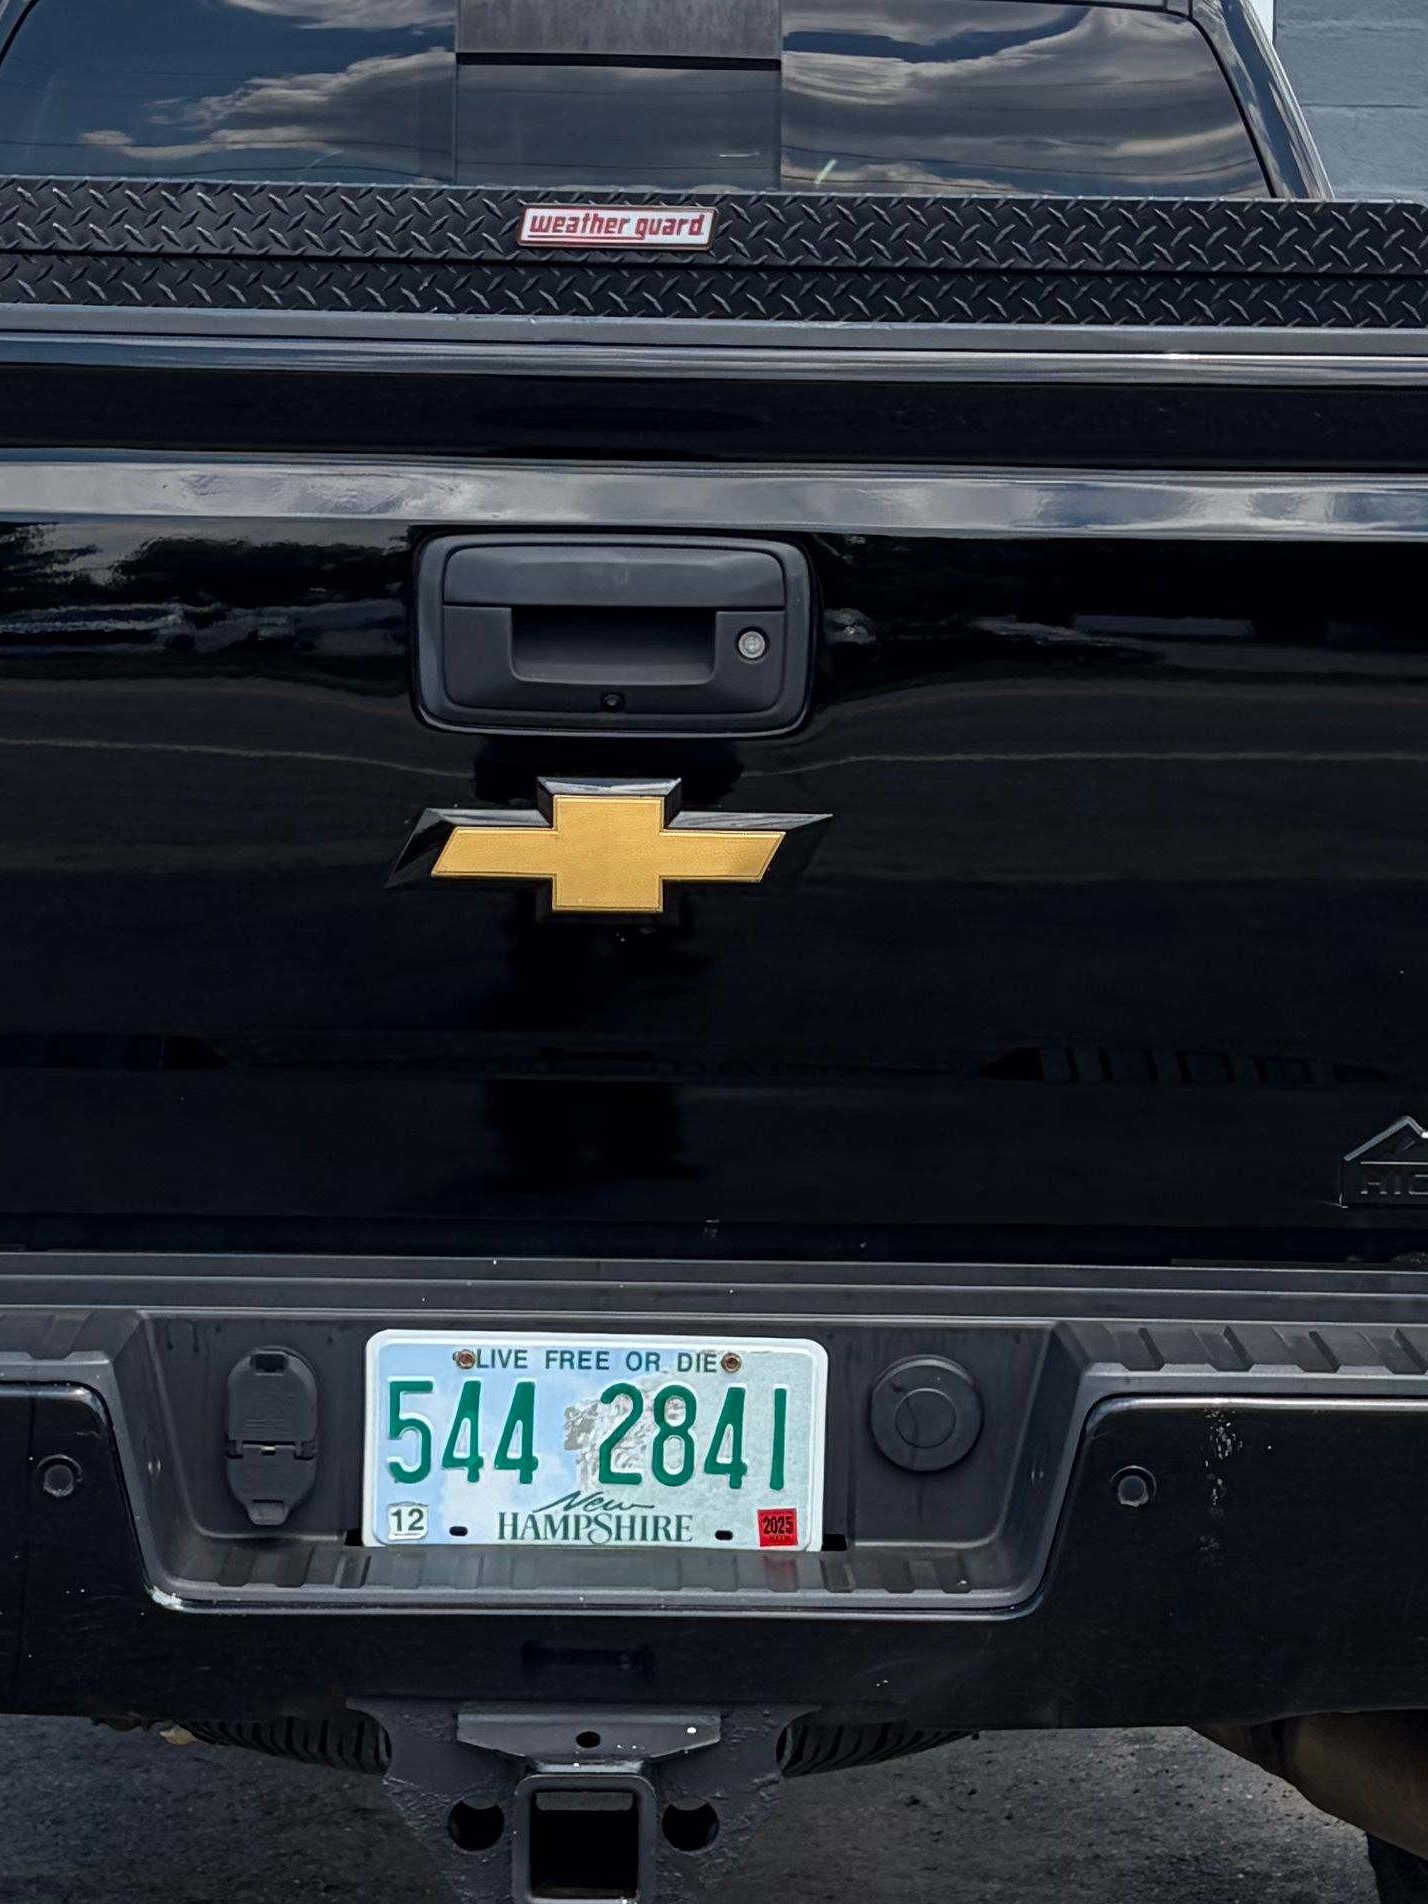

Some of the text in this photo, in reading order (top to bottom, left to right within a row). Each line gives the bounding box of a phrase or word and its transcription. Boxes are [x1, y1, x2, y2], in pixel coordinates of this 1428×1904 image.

[529, 213, 705, 241] weather guard
[475, 1348, 718, 1373] LIVE FREE OR DIE
[386, 1379, 788, 1490] 544 2841
[533, 1491, 655, 1514] New
[390, 1507, 426, 1533] 12
[497, 1511, 694, 1545] HAMPSHIRE
[762, 1515, 794, 1535] 2025
